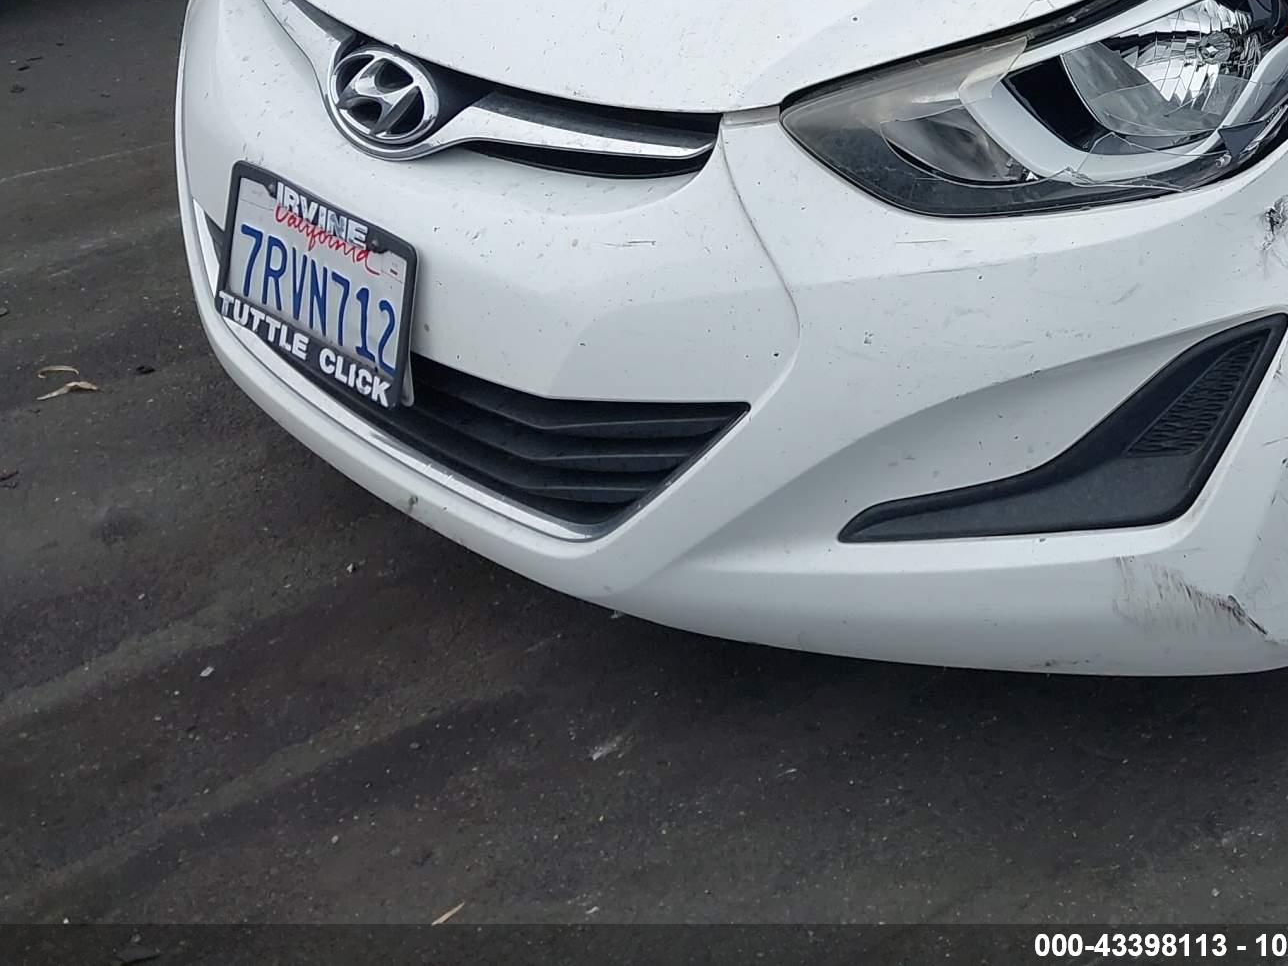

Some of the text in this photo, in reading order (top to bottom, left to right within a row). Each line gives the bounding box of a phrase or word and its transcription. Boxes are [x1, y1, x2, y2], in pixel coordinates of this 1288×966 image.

[276, 181, 368, 249] IRVINE
[218, 290, 391, 409] TUTTLE CLICK
[241, 223, 396, 376] 7RVN712
